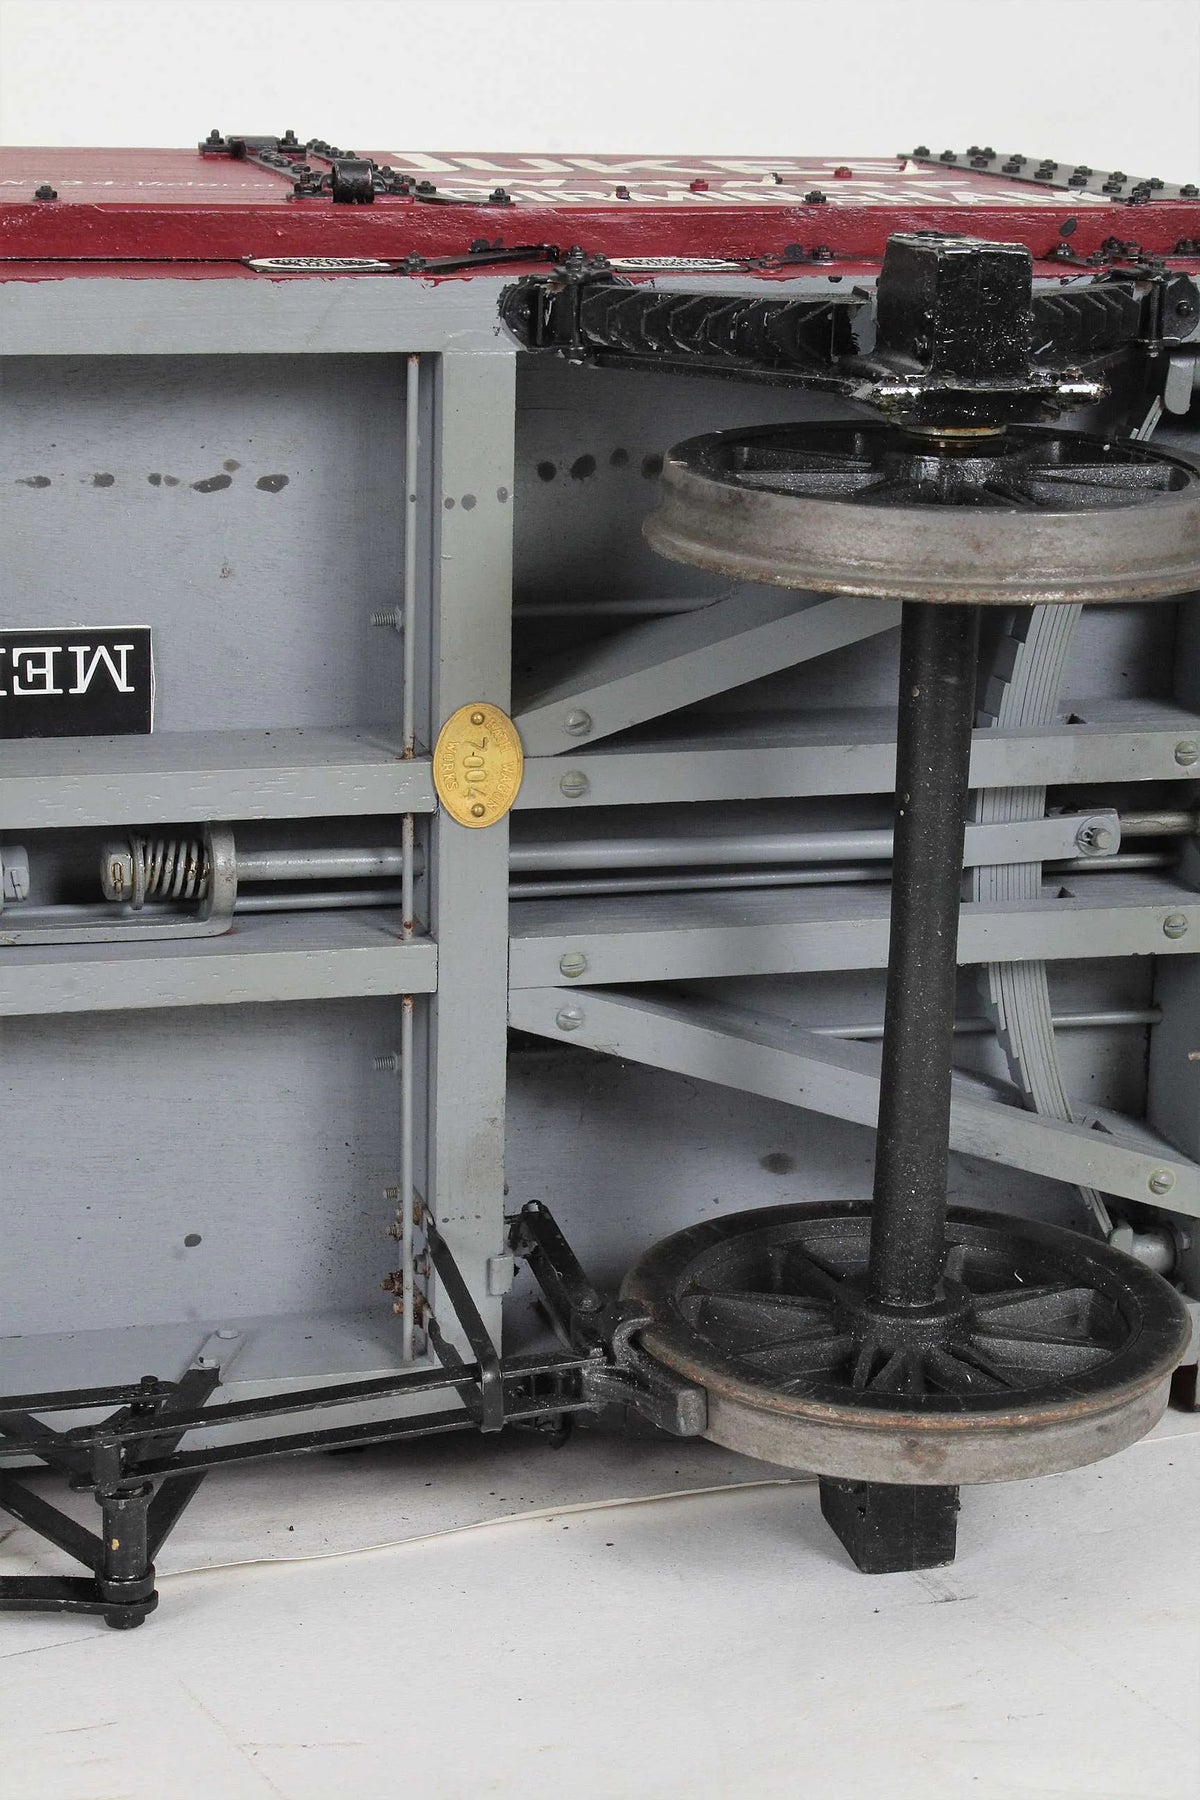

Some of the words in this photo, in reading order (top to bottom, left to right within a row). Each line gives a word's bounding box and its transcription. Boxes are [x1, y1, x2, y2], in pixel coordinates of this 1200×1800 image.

[391, 153, 935, 175] JUKES
[442, 740, 460, 792] WORKS
[486, 760, 514, 812] WAGON
